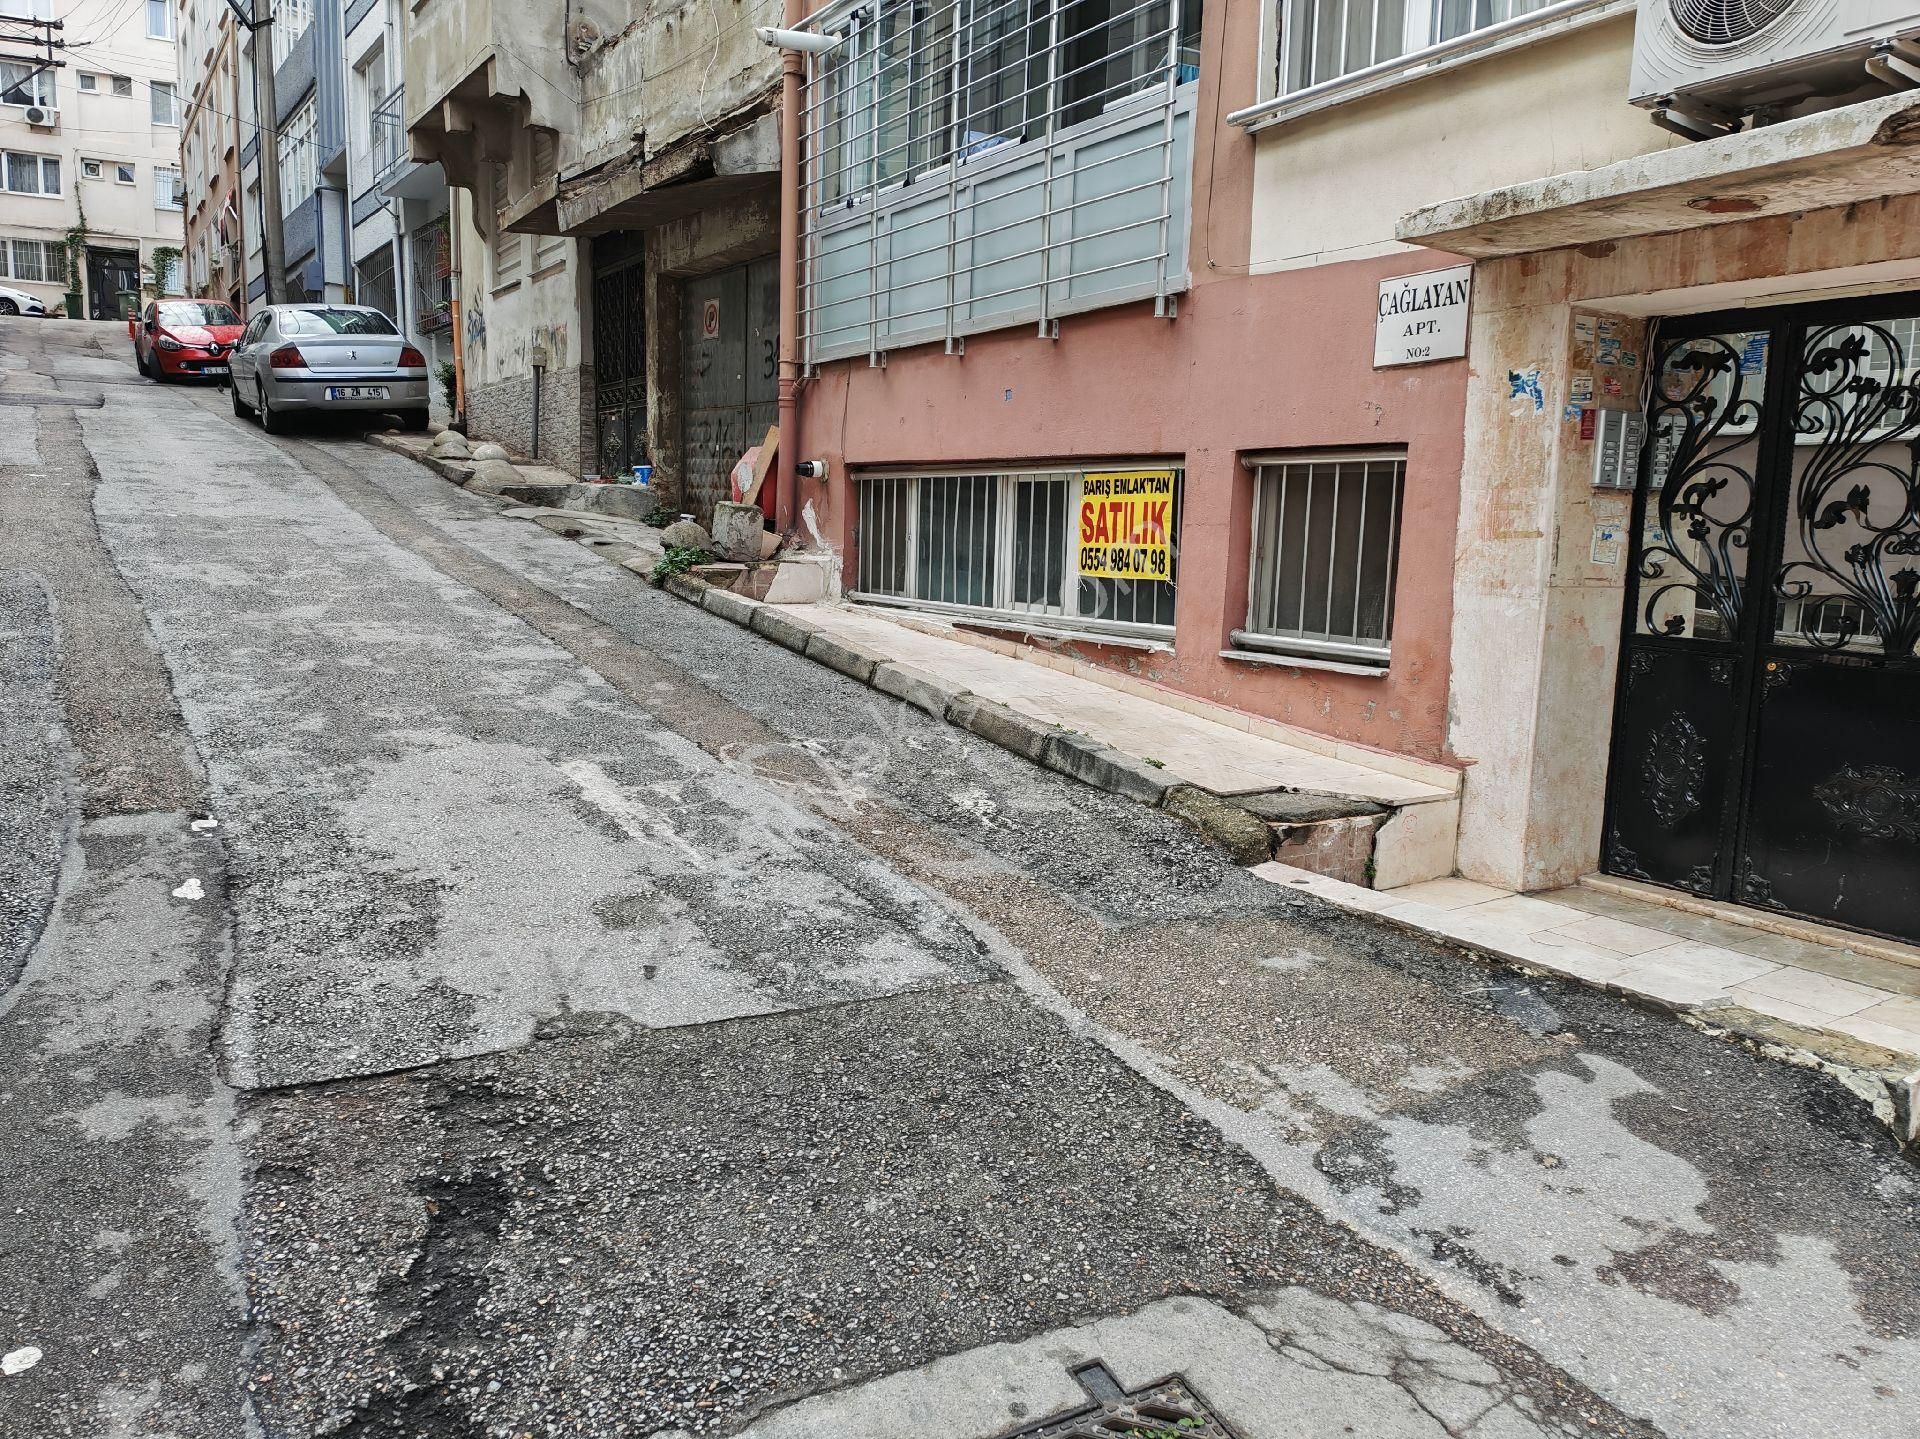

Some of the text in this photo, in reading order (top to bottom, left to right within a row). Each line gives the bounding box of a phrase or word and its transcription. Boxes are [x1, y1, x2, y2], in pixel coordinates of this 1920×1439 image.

[1379, 279, 1469, 323] ÇAĞLAYAN
[1403, 320, 1441, 337] APT.
[1406, 346, 1430, 360] NO:2
[337, 388, 346, 397] 16
[367, 388, 381, 397] 415
[1084, 477, 1171, 499] BARIŞ EMLAK'TAN
[1081, 501, 1169, 545] SATILIK
[1081, 546, 1166, 575] 0554 984 07 98
